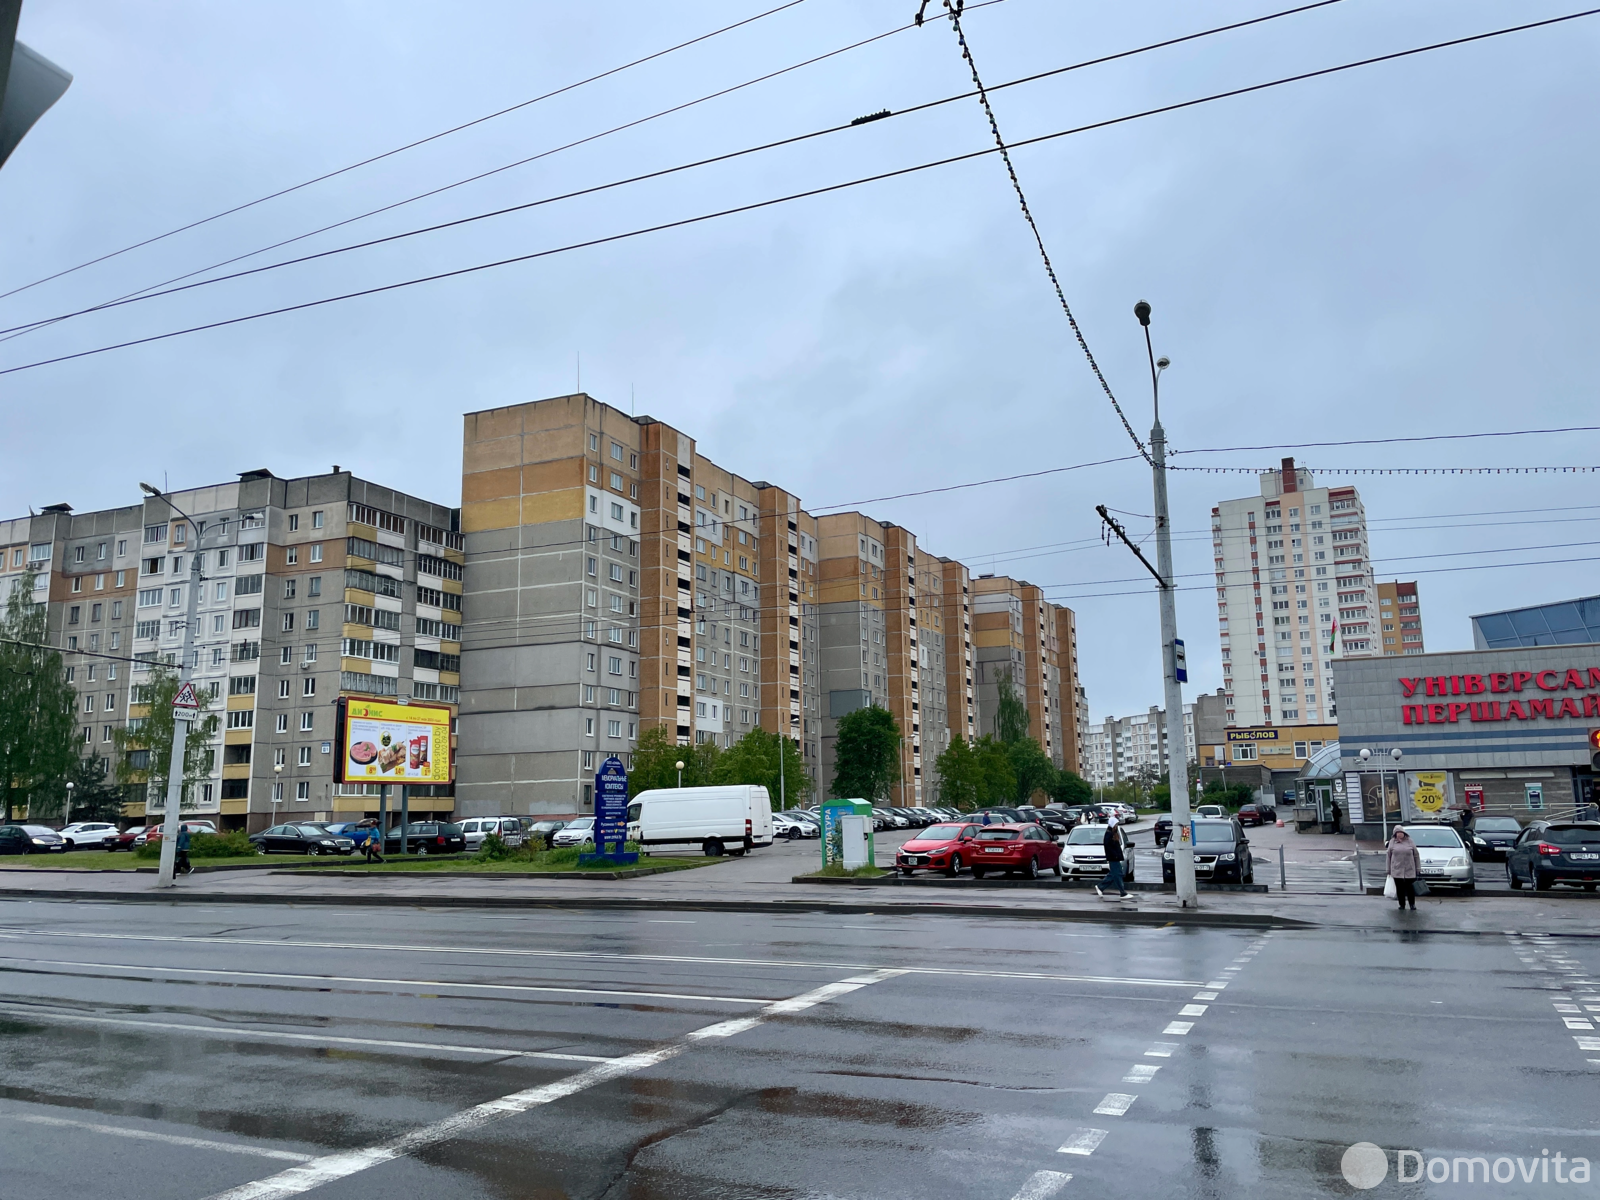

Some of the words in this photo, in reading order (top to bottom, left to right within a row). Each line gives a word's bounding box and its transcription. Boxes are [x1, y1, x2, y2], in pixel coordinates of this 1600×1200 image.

[433, 726, 441, 780] dionis-shop.by
[1230, 731, 1275, 739] РЫБОЛОВ
[825, 808, 833, 866] АКУЛАТУРА
